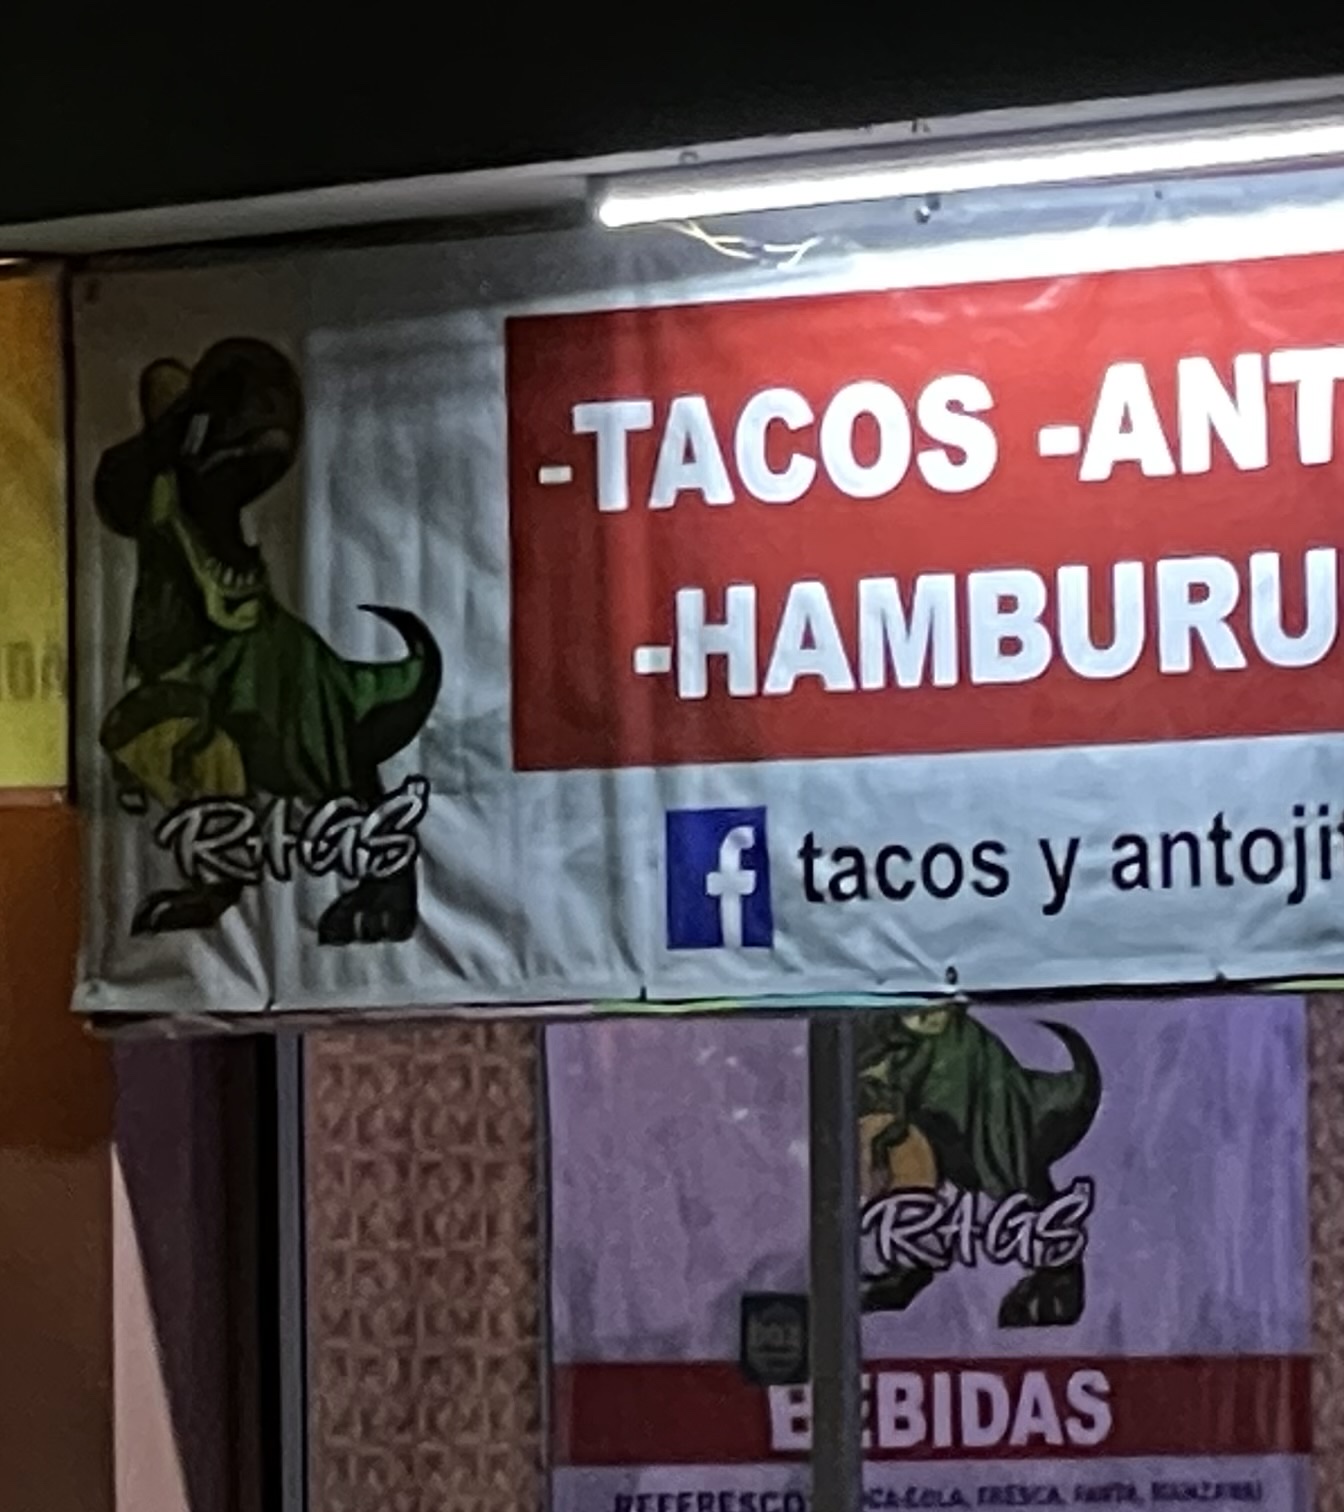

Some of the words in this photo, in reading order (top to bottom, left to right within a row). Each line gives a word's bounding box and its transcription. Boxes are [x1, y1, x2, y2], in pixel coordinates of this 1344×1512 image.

[538, 372, 1000, 513] -TACOS
[157, 774, 431, 884] RAGS
[797, 829, 1010, 905] tacos
[1039, 837, 1080, 915] y
[859, 1177, 1095, 1270] RAGS
[768, 1369, 1113, 1451] BBIDAS
